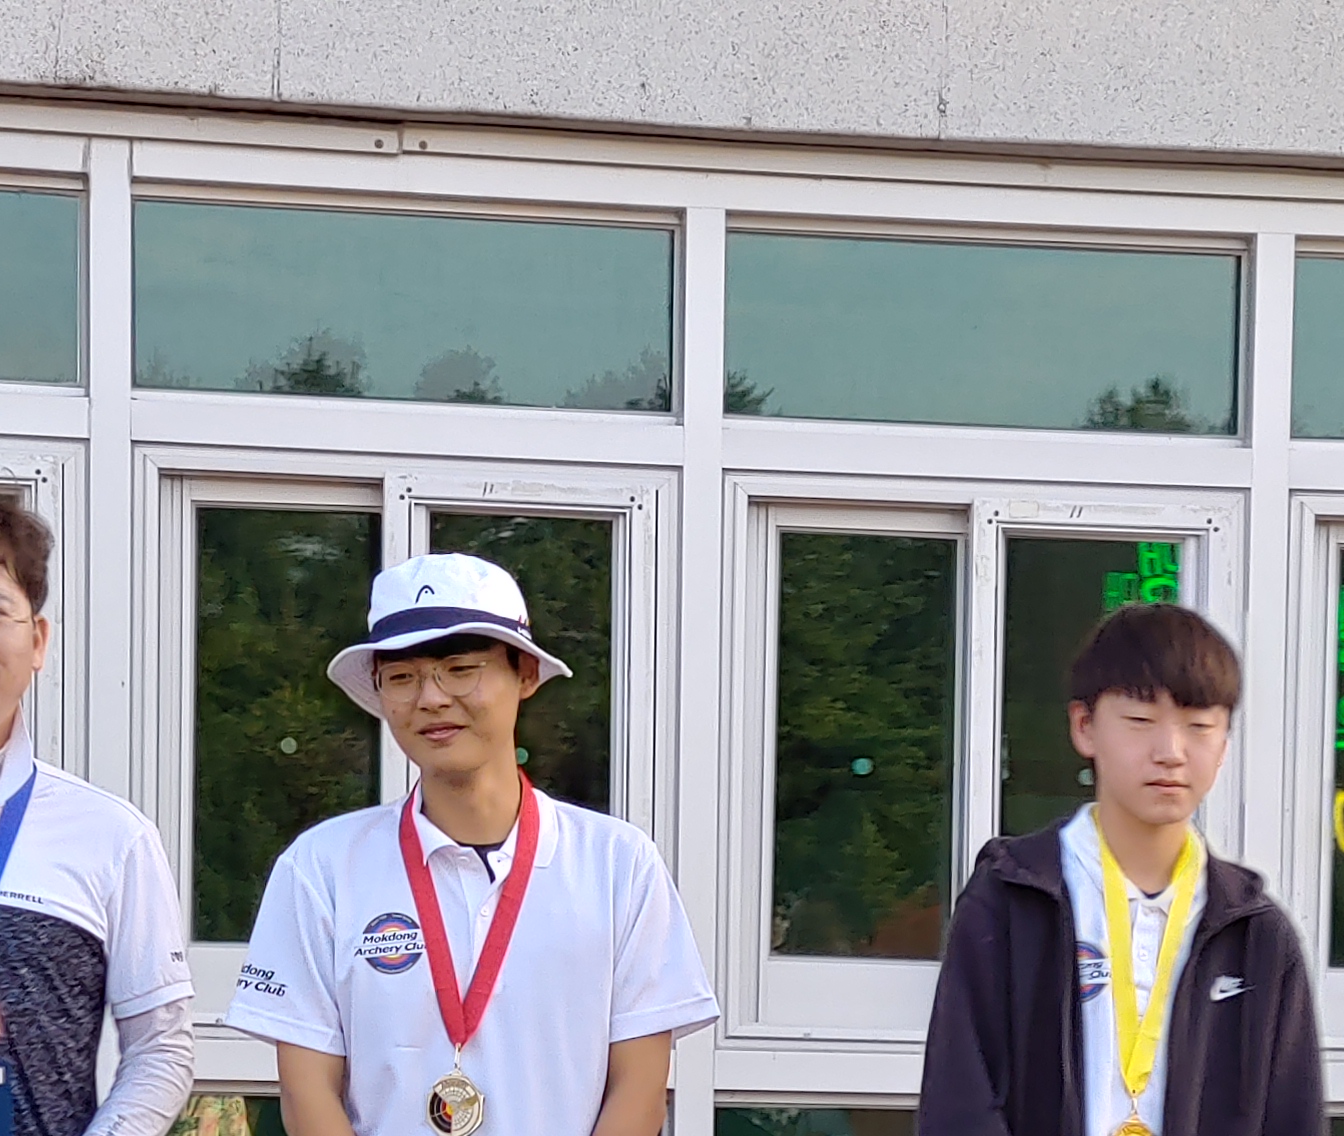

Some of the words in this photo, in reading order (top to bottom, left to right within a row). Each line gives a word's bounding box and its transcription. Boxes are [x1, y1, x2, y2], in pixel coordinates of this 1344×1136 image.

[362, 931, 418, 945] Mokdong
[353, 944, 403, 958] Archery
[404, 941, 427, 952] Clu
[254, 981, 286, 997] Club
